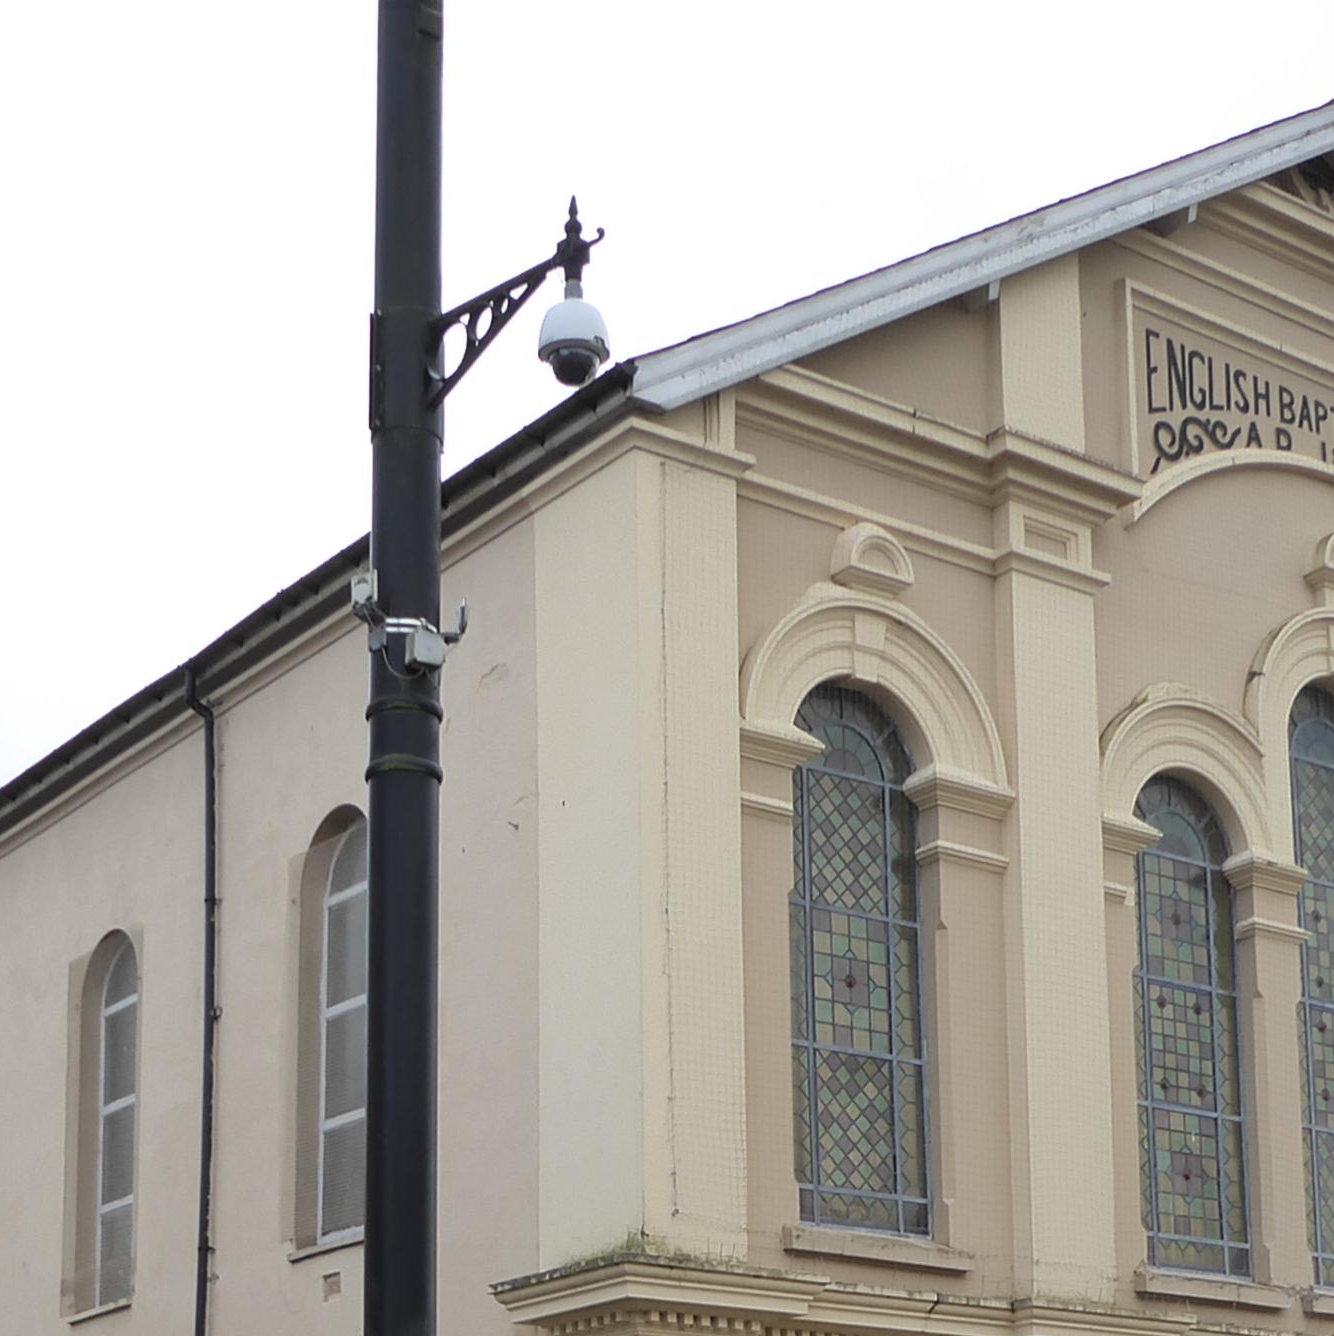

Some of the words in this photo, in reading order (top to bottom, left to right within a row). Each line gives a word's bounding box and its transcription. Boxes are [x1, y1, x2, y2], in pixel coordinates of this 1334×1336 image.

[1145, 328, 1271, 417] ENGLISH
[1246, 421, 1263, 449] A
[1276, 427, 1293, 452] D
